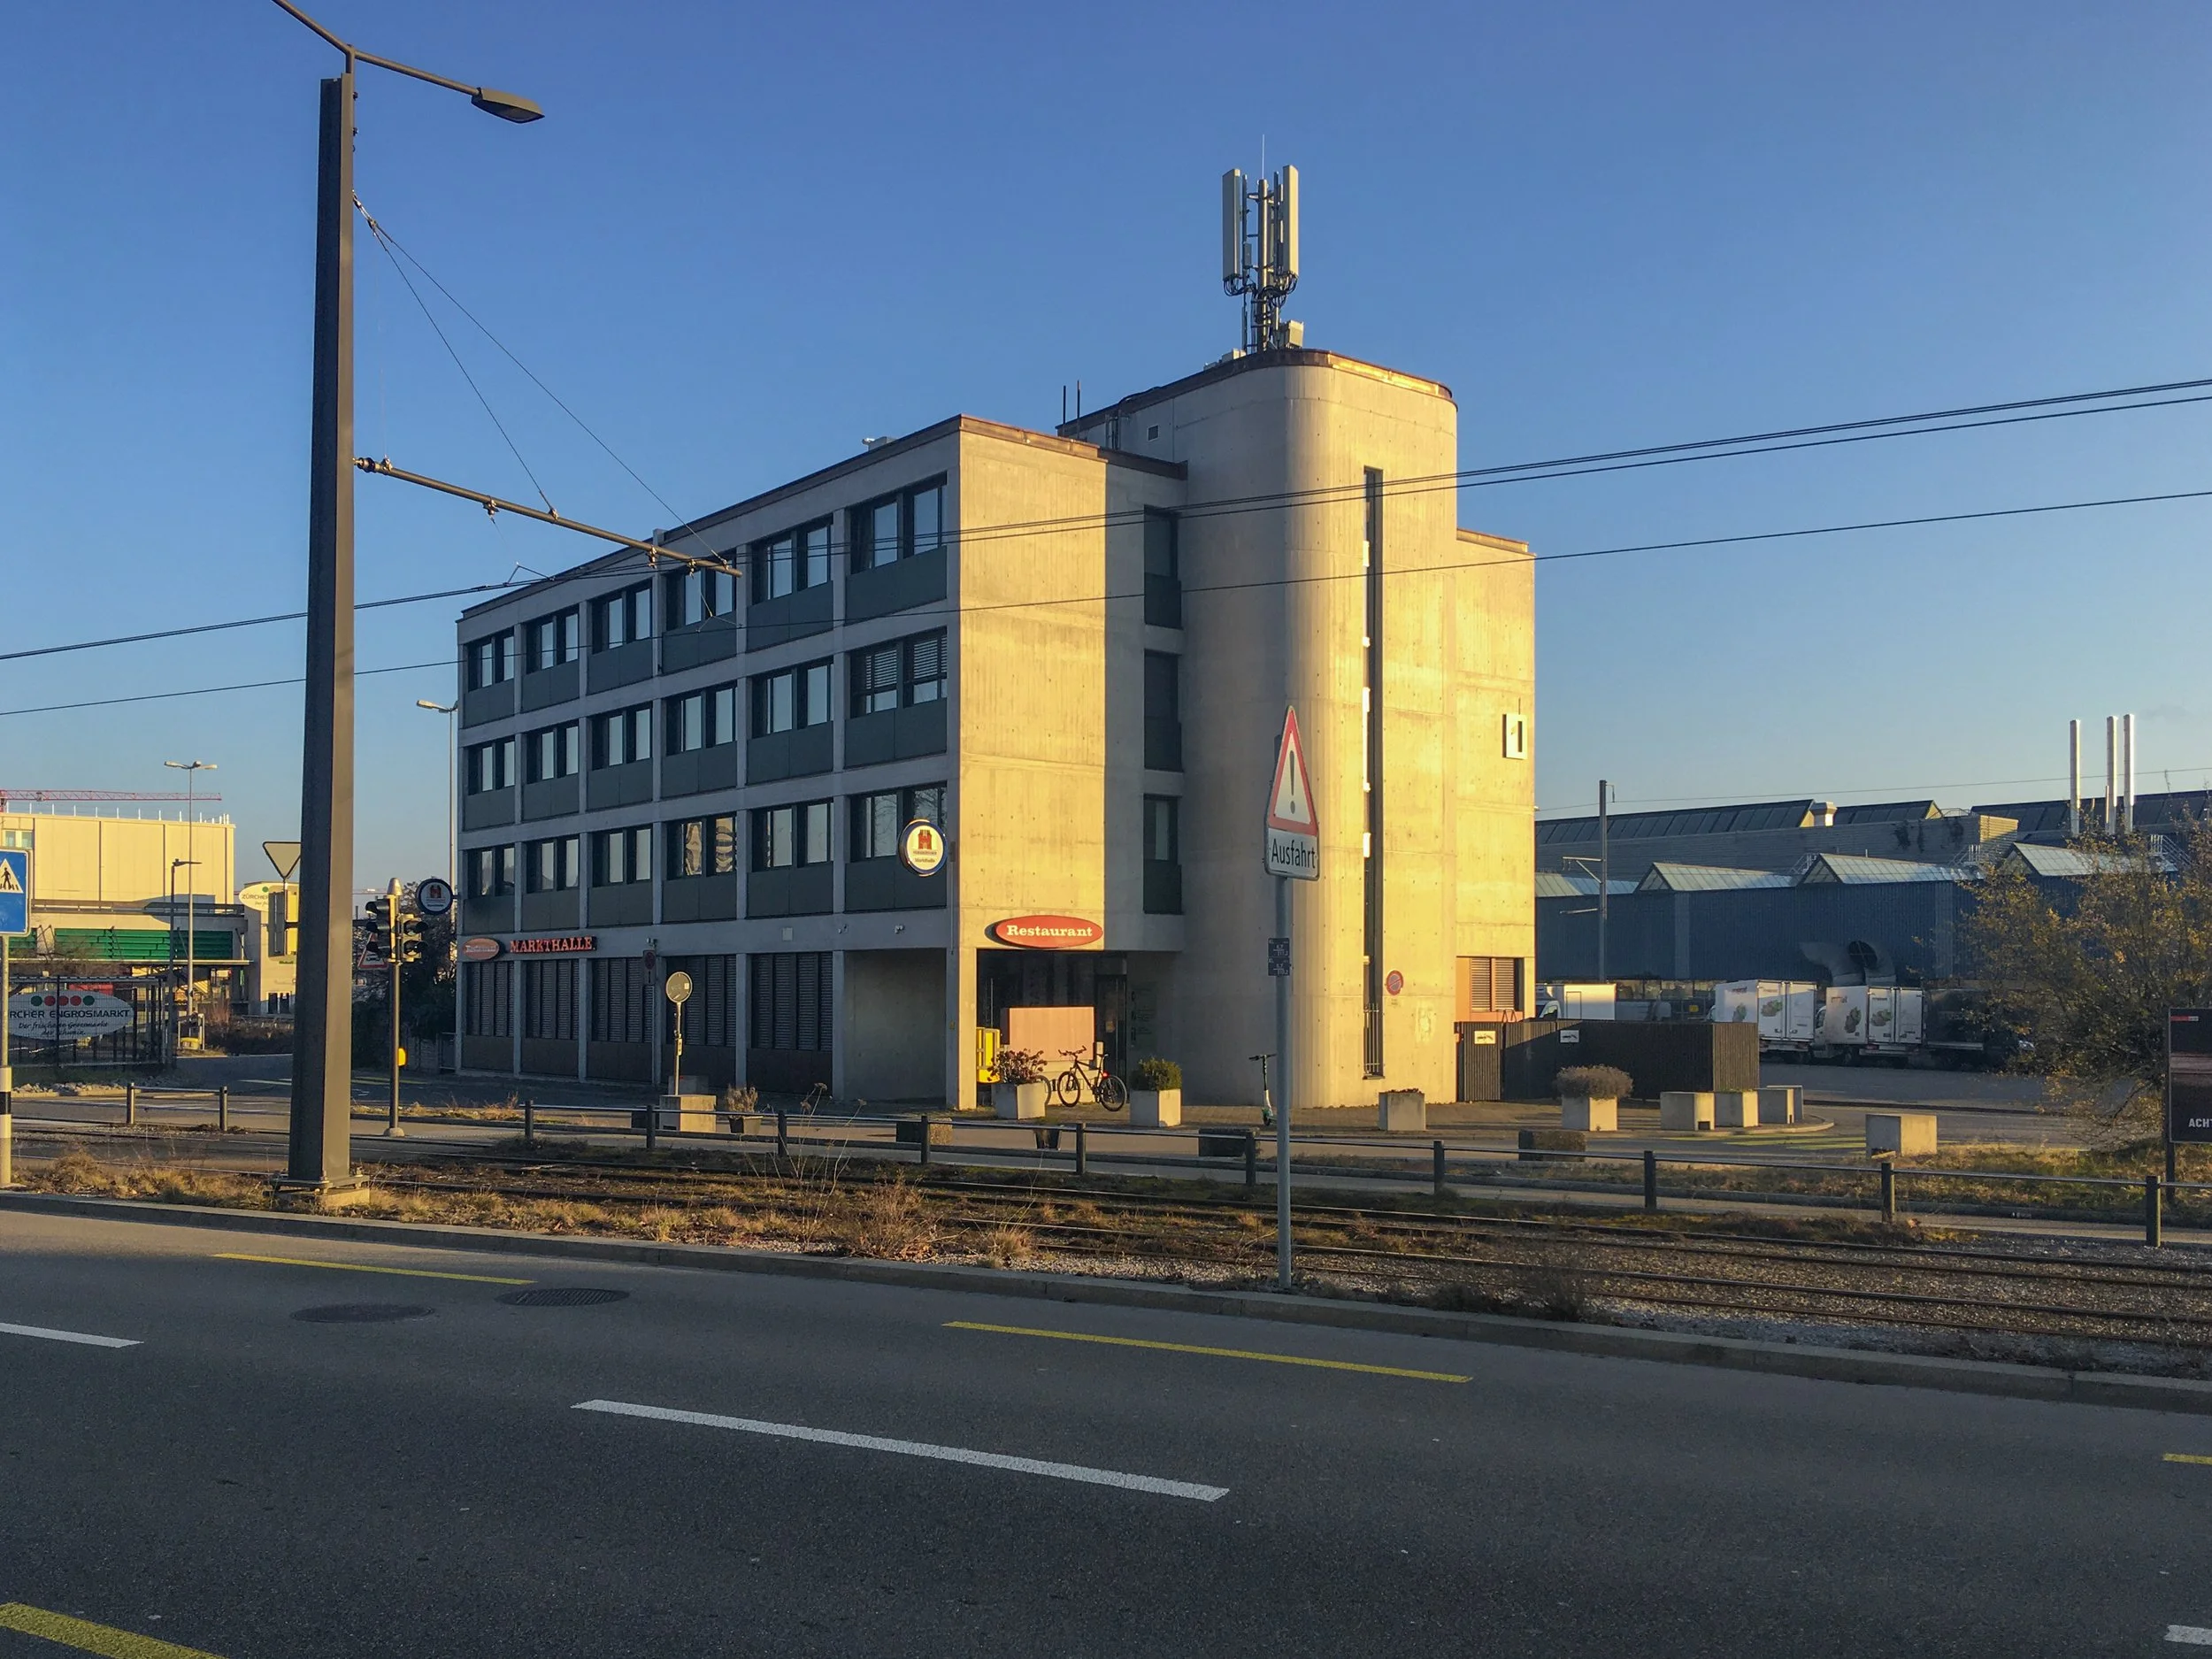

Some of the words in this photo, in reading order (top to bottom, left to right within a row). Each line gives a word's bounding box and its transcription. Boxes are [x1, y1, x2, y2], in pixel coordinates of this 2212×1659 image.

[1271, 838, 1316, 869] Ausfahrt
[1006, 925, 1093, 937] Restaurant
[10, 1010, 45, 1018] RCHER
[50, 1010, 130, 1018] ENGROSMARKT
[2188, 1118, 2212, 1128] ACH
